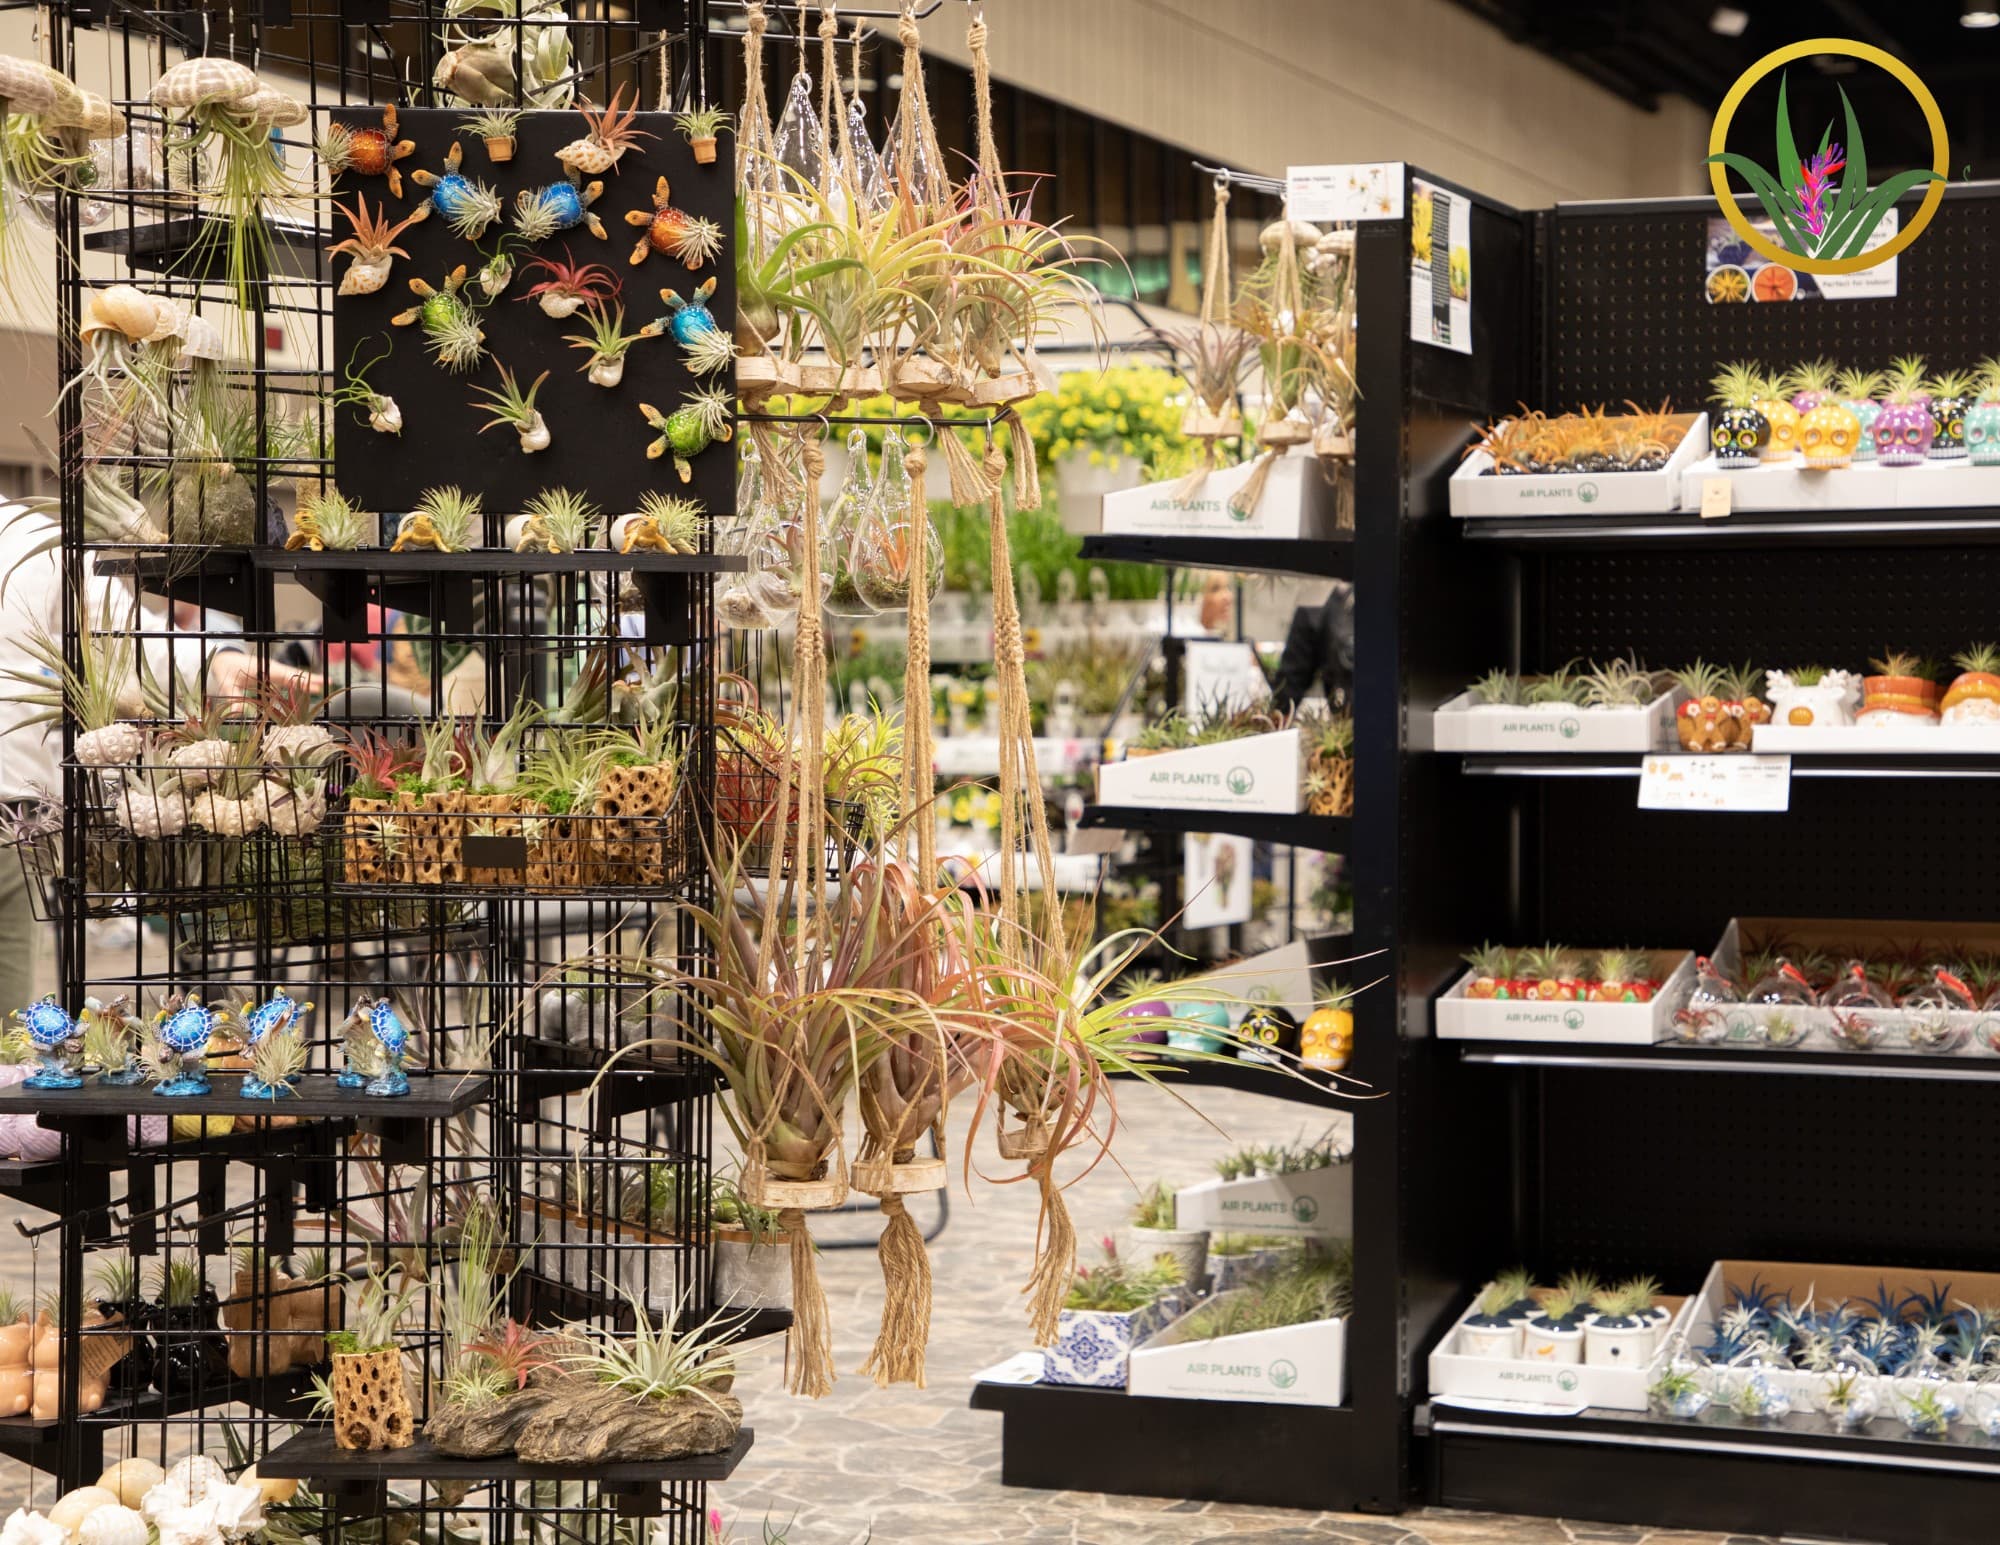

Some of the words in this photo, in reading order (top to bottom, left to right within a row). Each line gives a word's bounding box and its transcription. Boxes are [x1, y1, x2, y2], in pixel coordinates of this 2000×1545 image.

[1520, 489, 1535, 498] AIR
[1537, 488, 1573, 498] PLANTS
[1150, 500, 1170, 511] AIR
[1503, 723, 1517, 732] AIR
[1519, 723, 1555, 733] PLANTS
[1150, 772, 1170, 783] AIR
[1173, 773, 1221, 785] PLANTS
[1506, 1013, 1521, 1022] AIR
[1523, 1014, 1559, 1024] PLANTS
[1221, 1200, 1239, 1211] AIR
[1242, 1201, 1287, 1213] PLANTS
[1186, 1362, 1211, 1375] AIR
[1212, 1364, 1262, 1378] PLANTS
[1498, 1371, 1514, 1380] AIR
[1516, 1372, 1553, 1384] PLANTS
